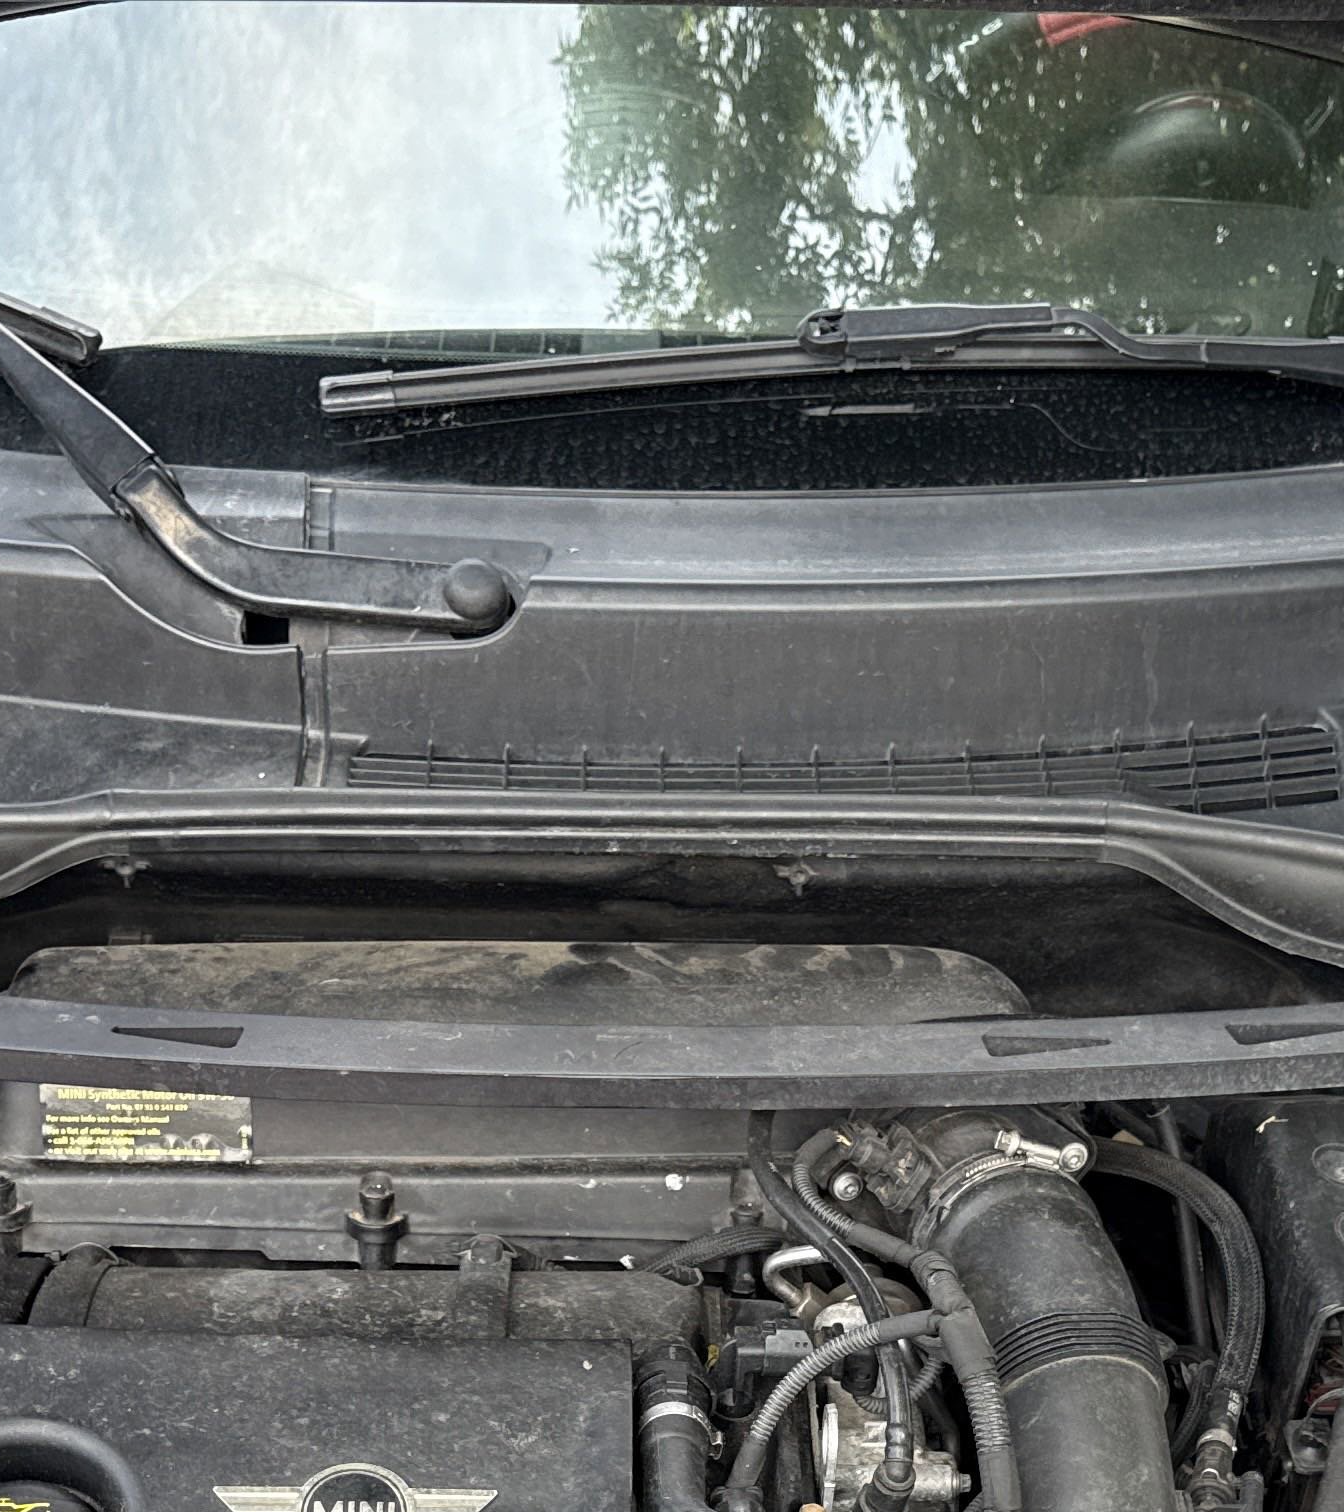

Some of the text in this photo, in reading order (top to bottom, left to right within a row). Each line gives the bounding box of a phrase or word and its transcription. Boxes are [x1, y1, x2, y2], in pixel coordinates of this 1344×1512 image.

[57, 1088, 87, 1100] MINI
[88, 1088, 141, 1103] Synthetic
[142, 1091, 176, 1100] Motor
[81, 1114, 96, 1123] info
